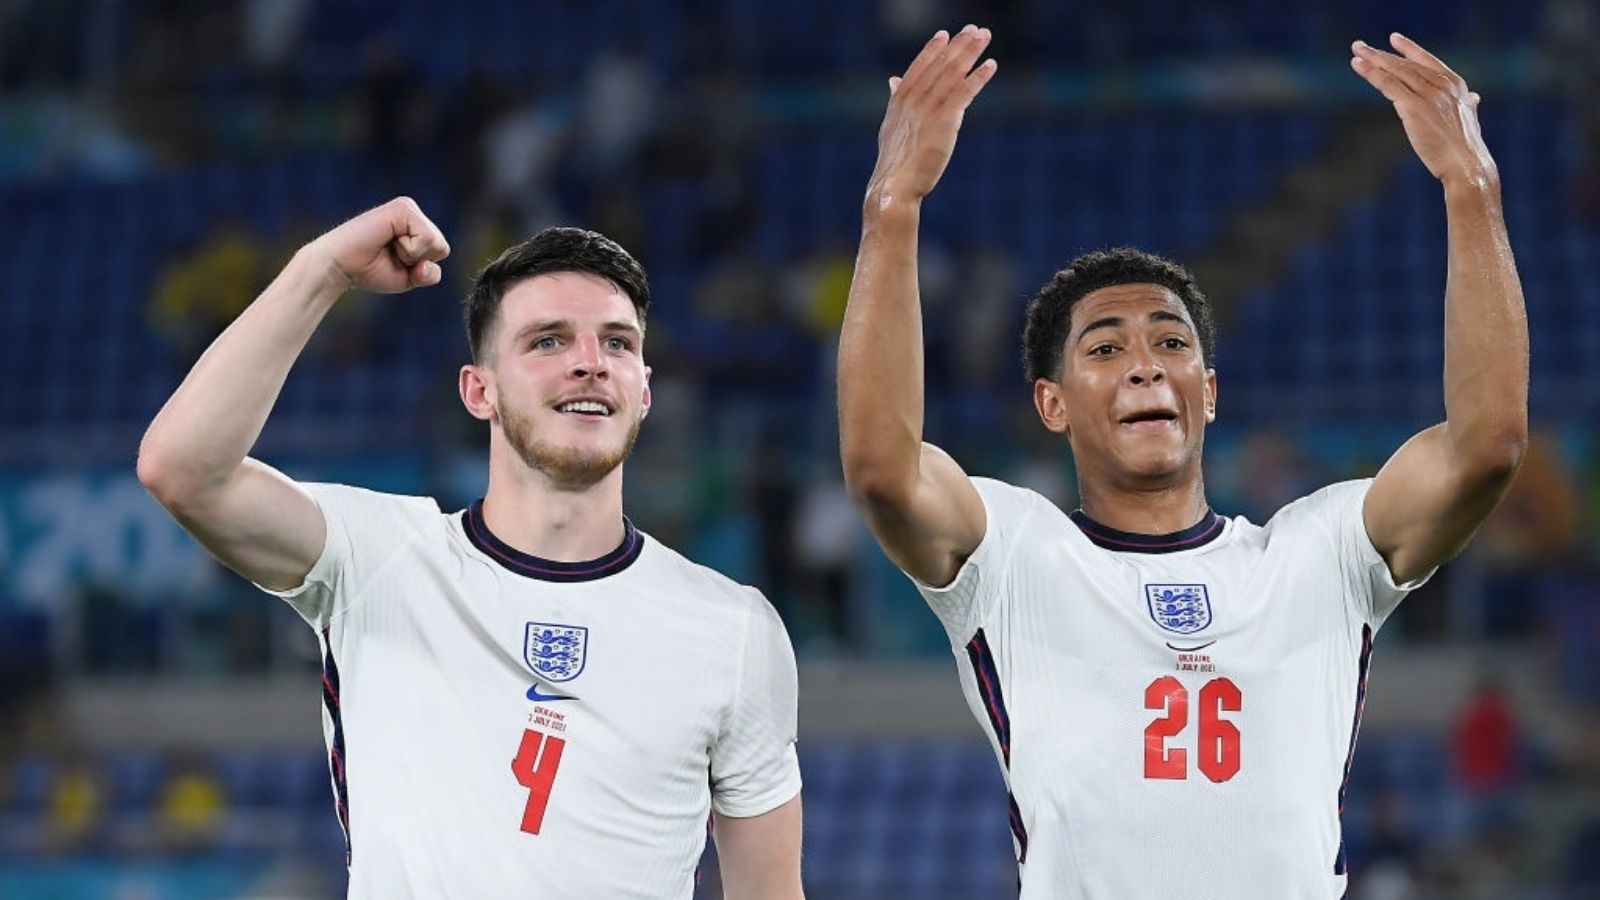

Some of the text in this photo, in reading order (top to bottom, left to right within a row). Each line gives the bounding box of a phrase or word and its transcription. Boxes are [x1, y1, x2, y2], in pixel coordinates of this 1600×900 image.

[1178, 653, 1211, 663] UKRAINE
[1181, 663, 1199, 672] JULY
[1200, 663, 1216, 673] 2021
[534, 705, 566, 721] UKRAINE
[533, 715, 551, 727] JULY
[551, 720, 567, 732] 2021
[1143, 674, 1242, 783] 26
[510, 727, 566, 836] 4
